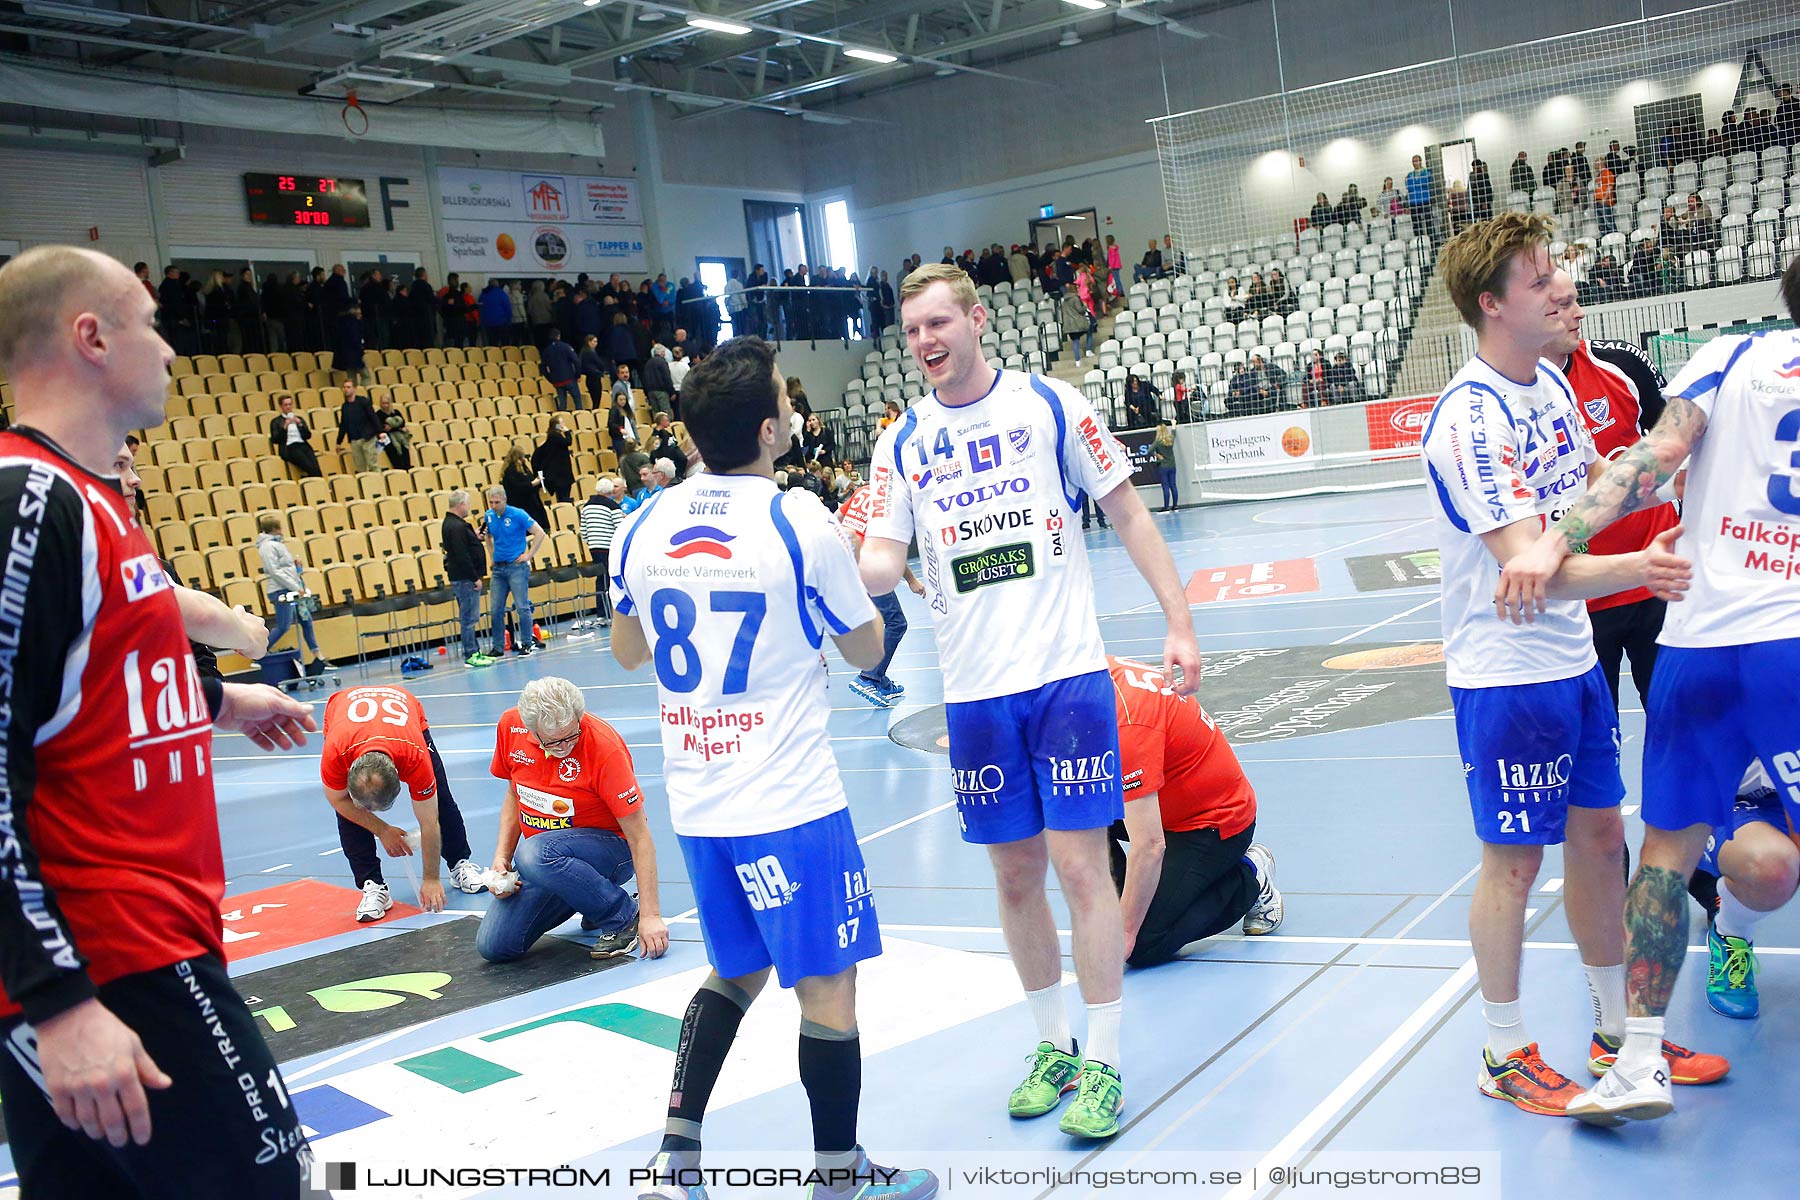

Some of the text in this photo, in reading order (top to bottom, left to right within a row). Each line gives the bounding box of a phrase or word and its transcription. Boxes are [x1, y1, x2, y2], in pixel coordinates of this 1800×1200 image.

[278, 176, 335, 193] 25 27
[306, 196, 313, 207] 2
[379, 176, 409, 231] F
[597, 240, 629, 251] TAPPER
[912, 427, 955, 466] 14
[1079, 416, 1113, 472] MAXI
[1211, 433, 1271, 450] Bergslagens
[933, 460, 961, 476] INTER
[1218, 448, 1266, 464] Sparbank
[935, 469, 963, 485] SPORT
[689, 501, 730, 516] SIFRE
[934, 478, 1030, 513] VOLVO
[959, 509, 1034, 541] SKÖVDE
[646, 564, 756, 579] Skövde Värmeverk
[958, 548, 1026, 576] GRÖNSAKS
[976, 562, 1018, 584] HUSET
[650, 587, 767, 696] 87
[661, 704, 765, 735] Falköpings
[683, 733, 741, 762] Mejeri
[520, 811, 571, 830] TORMEK
[1497, 809, 1531, 833] 21
[837, 917, 860, 949] 87
[175, 960, 269, 1122] PRO TRAINING
[266, 1068, 289, 1109] 1
